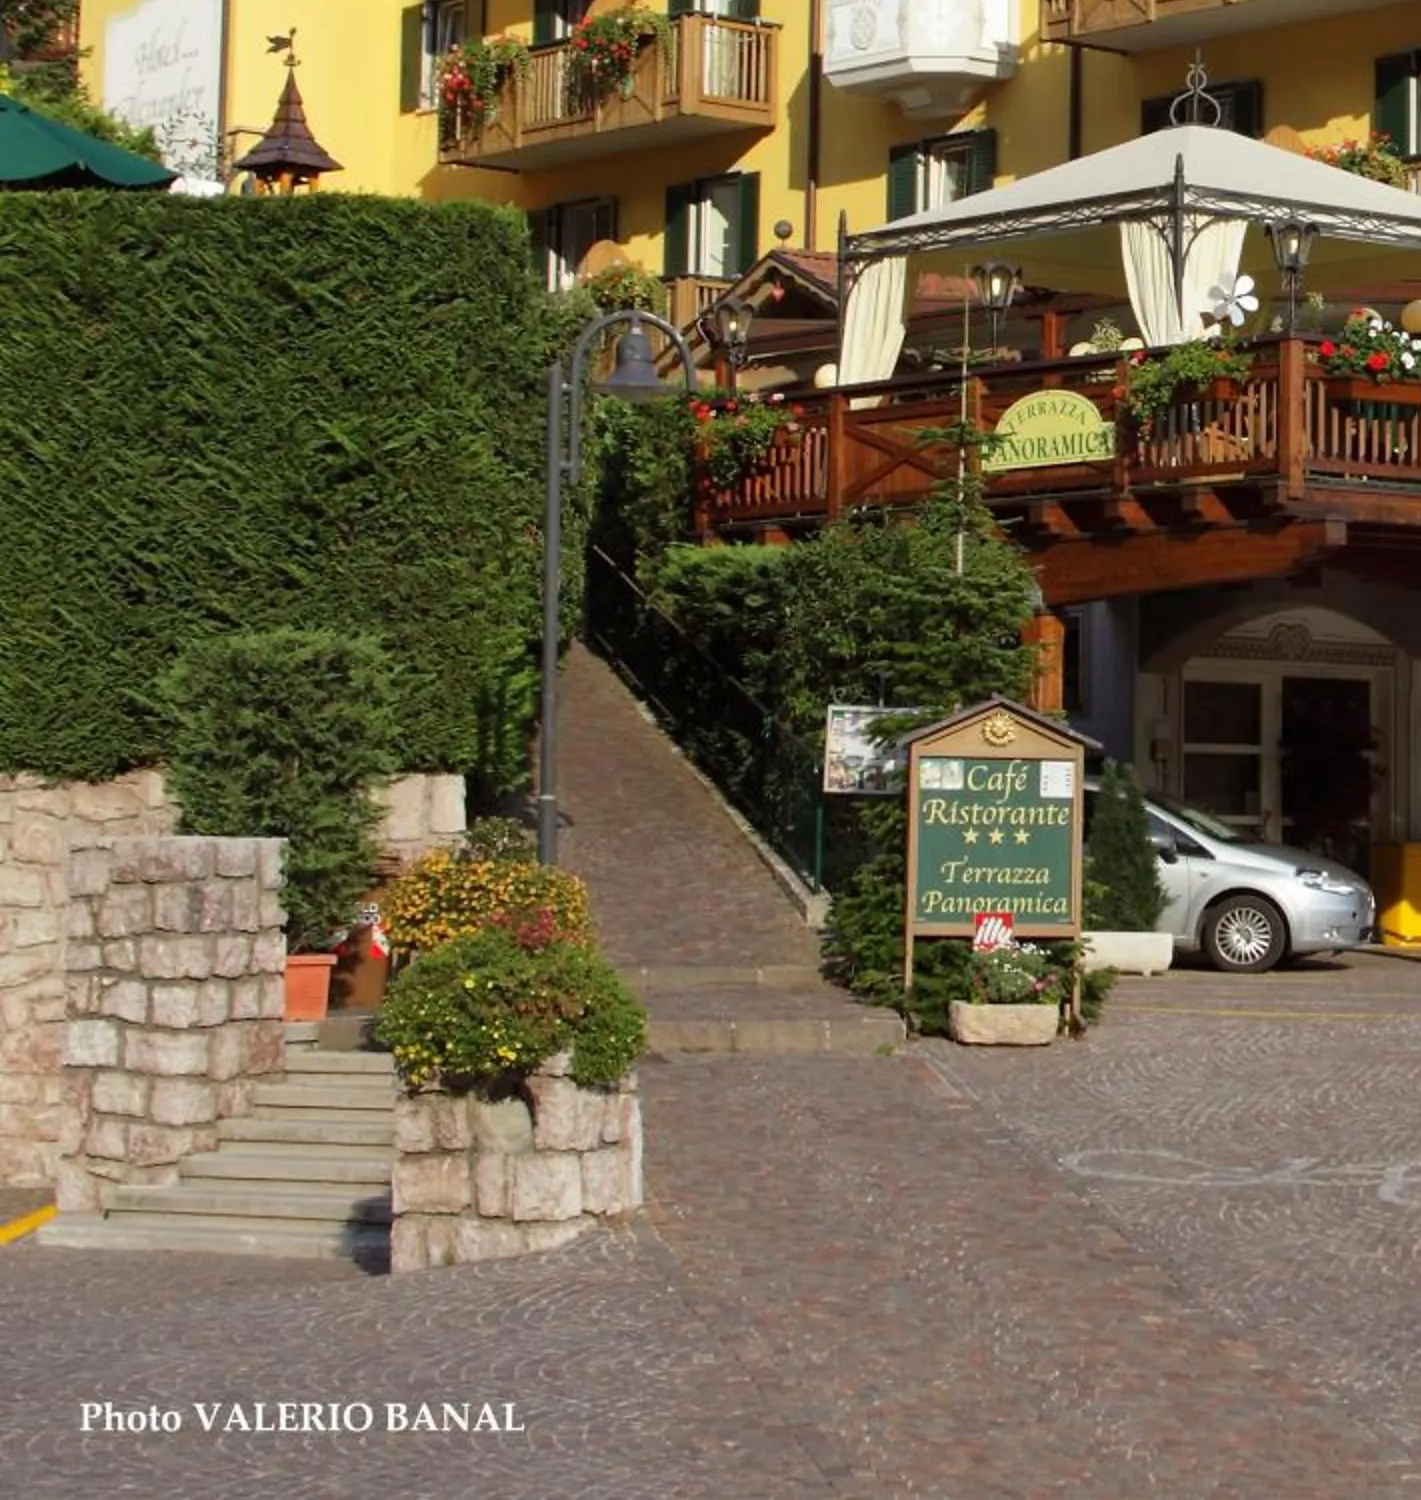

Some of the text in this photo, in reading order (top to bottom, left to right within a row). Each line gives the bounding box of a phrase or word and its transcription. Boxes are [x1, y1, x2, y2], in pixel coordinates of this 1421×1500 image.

[1006, 400, 1086, 433] TERRAZZA
[988, 429, 1110, 462] ANORAMICA
[967, 760, 1030, 804] Café
[923, 797, 1070, 825] Ristorante
[941, 855, 1050, 884] Terrazza
[921, 889, 1069, 913] Panoramica
